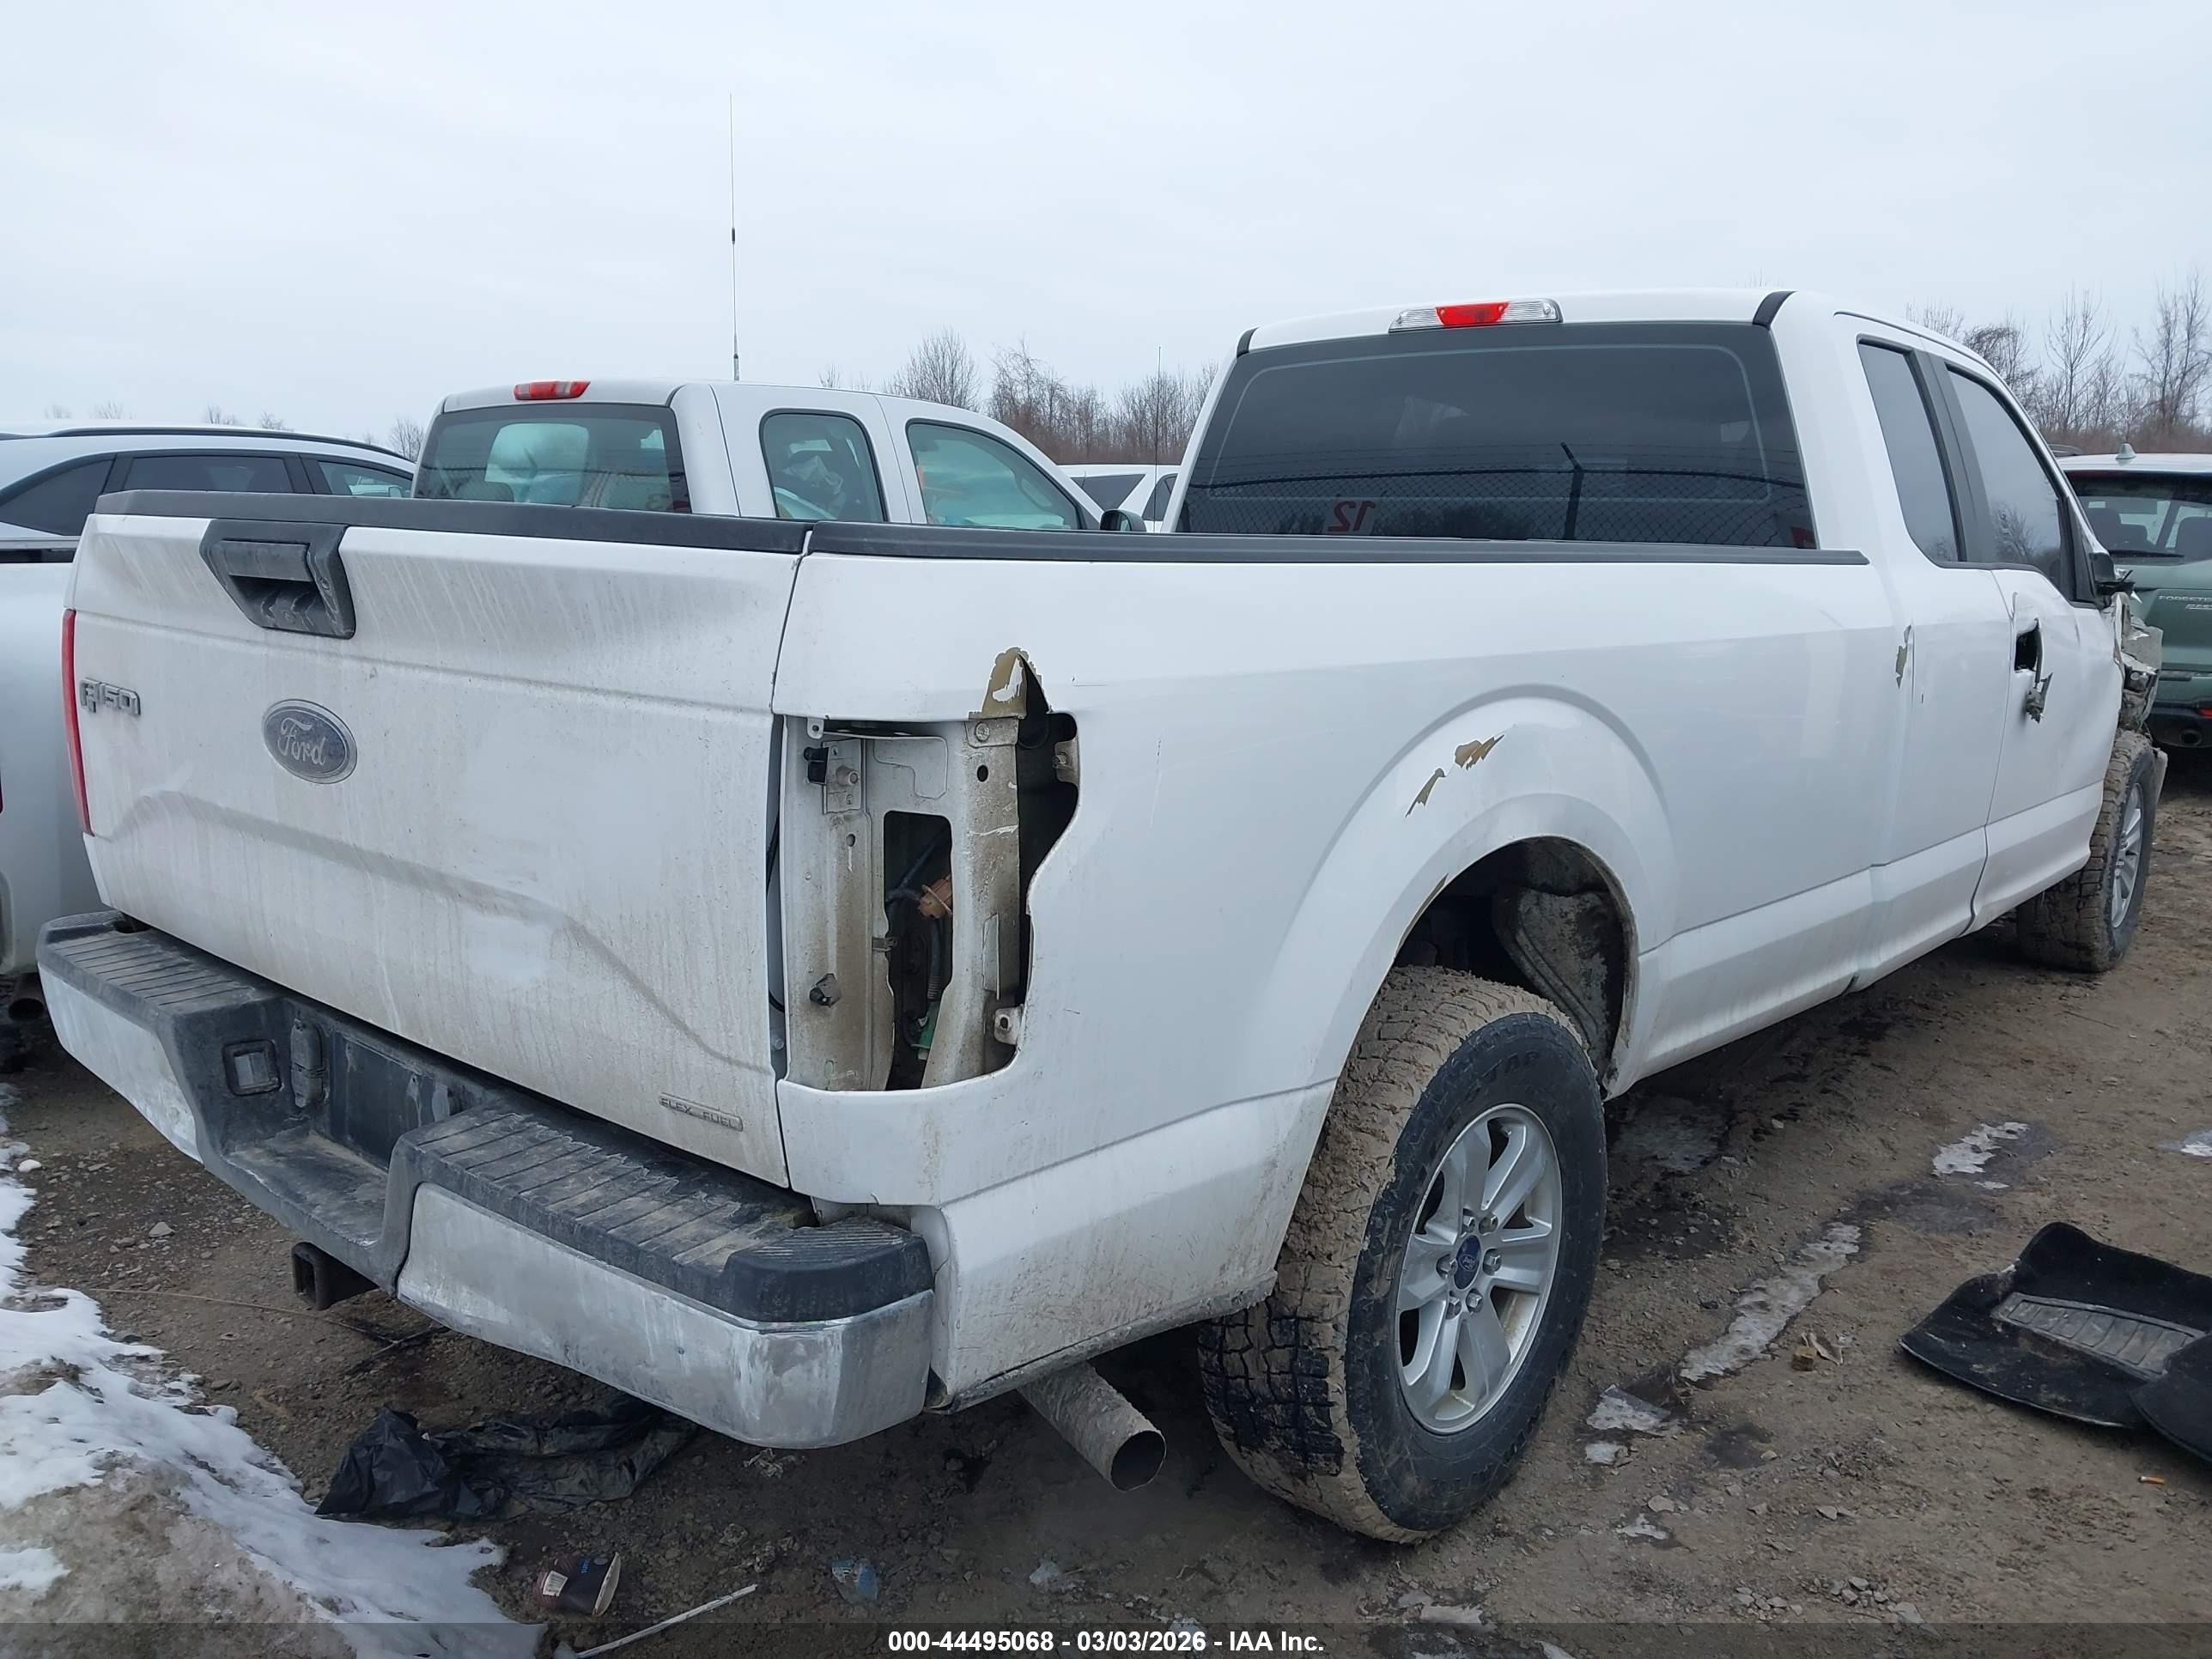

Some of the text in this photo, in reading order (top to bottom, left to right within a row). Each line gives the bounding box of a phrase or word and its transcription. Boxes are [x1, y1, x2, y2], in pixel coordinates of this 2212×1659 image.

[277, 717, 326, 765] Ford
[659, 1097, 736, 1130] FLEX FUEL
